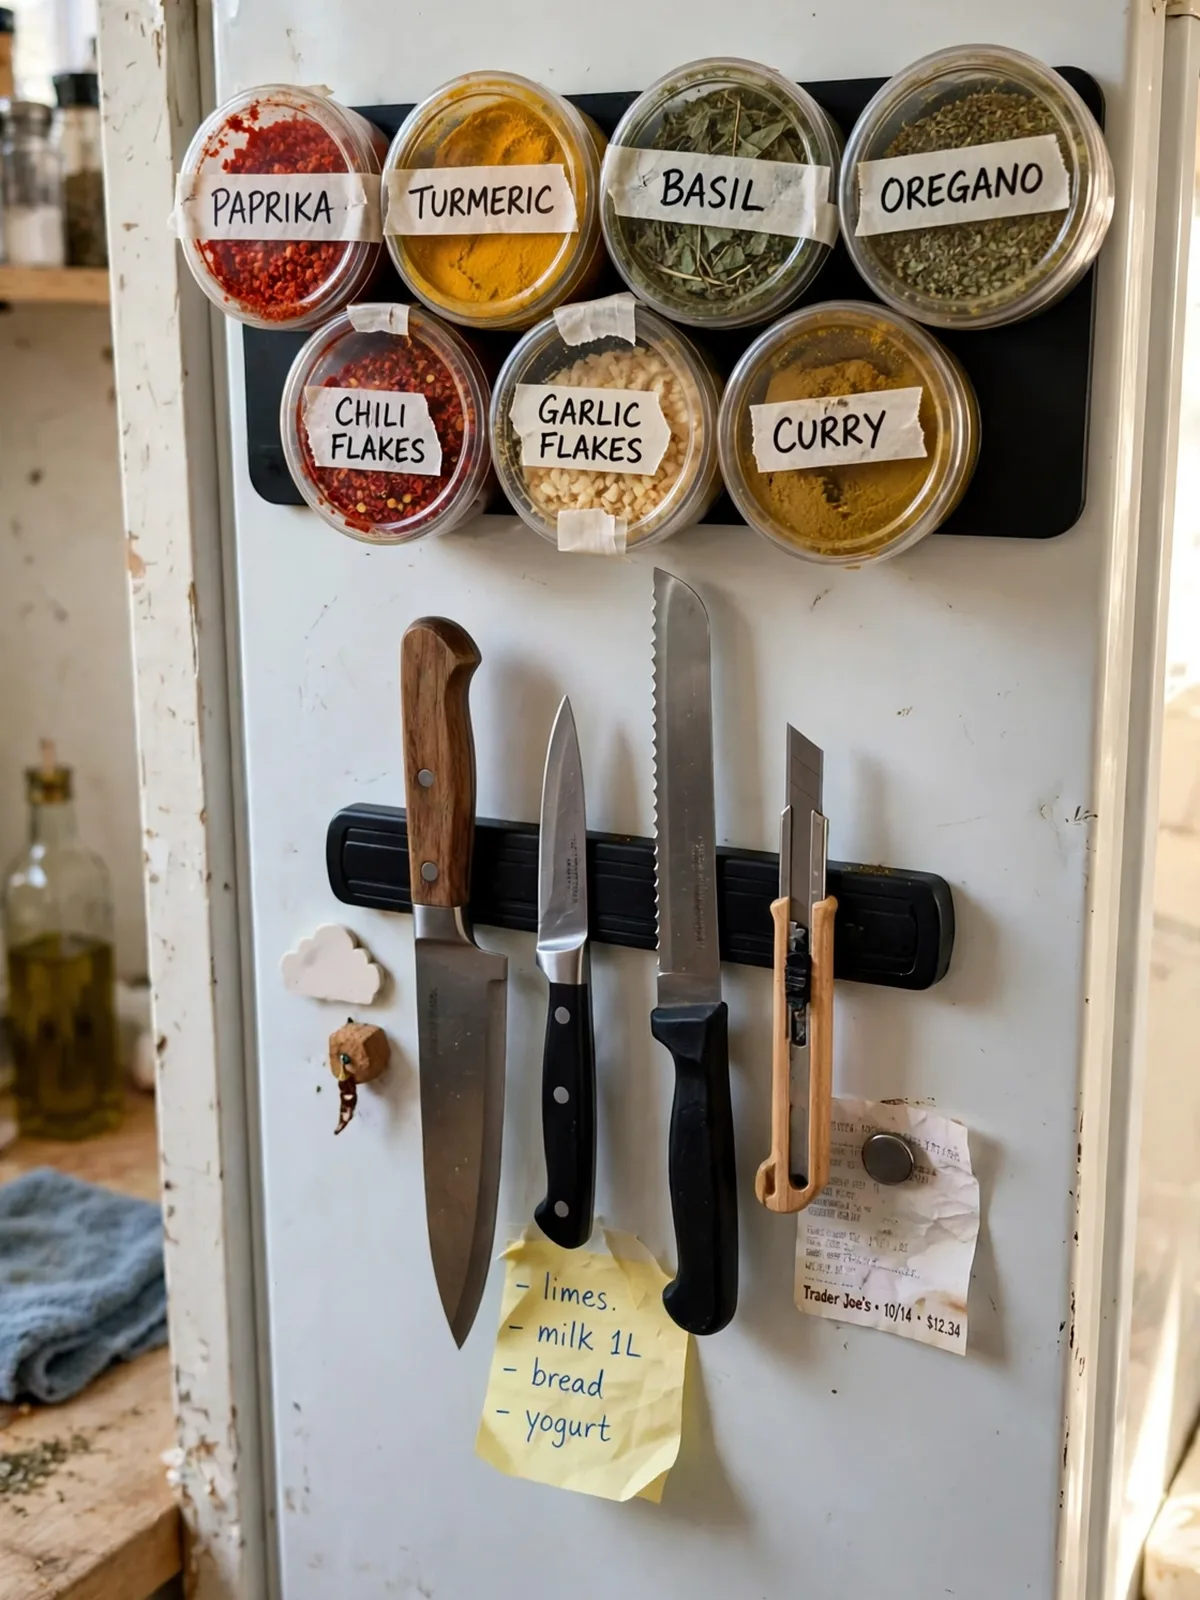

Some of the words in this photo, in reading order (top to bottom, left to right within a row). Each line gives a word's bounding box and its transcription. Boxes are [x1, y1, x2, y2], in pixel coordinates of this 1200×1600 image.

[211, 187, 335, 227] PAPRIKA
[408, 184, 555, 220] TURMERIC
[661, 168, 765, 212] BASIL
[880, 162, 1044, 213] OREGANO
[335, 395, 406, 429] CHILI
[538, 393, 641, 428] GARLIC
[331, 432, 425, 464] FLAKES
[540, 431, 643, 464] FLAKES
[773, 409, 887, 454] CURRY
[544, 1271, 616, 1311] limes.
[803, 1285, 840, 1305] Trader
[843, 1293, 872, 1312] Joe's
[884, 1303, 912, 1322] 10/14
[927, 1314, 961, 1338] $12.34
[538, 1320, 594, 1351] milk
[610, 1329, 642, 1358] 1L
[532, 1356, 604, 1400] bread
[525, 1409, 611, 1448] yogurt
